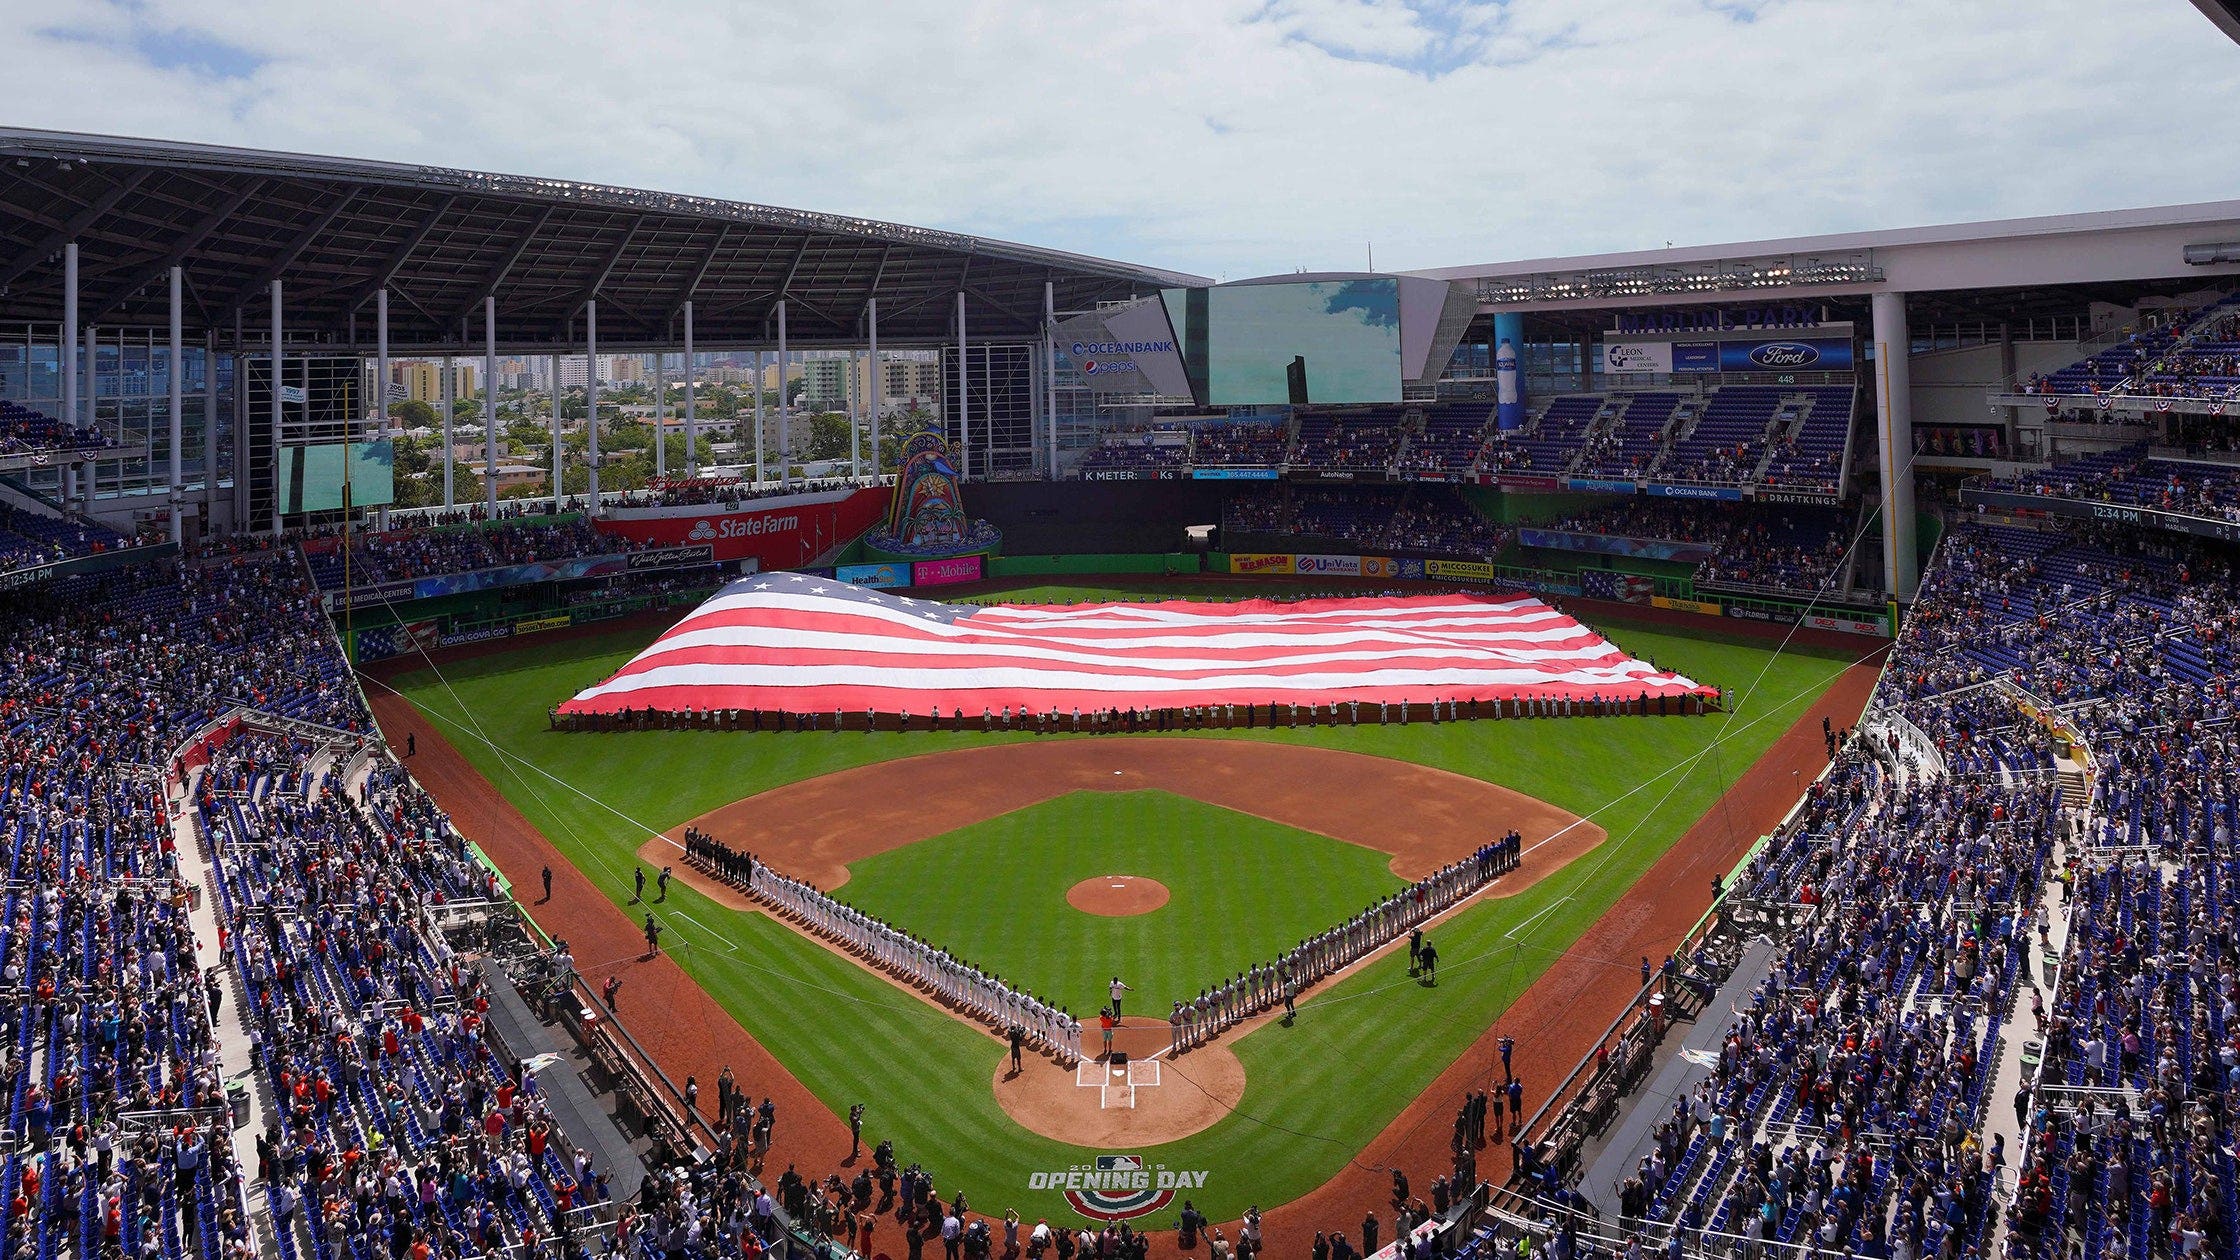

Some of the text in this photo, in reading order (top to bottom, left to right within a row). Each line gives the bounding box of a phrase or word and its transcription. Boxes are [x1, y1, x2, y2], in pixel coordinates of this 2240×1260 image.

[1620, 307, 1820, 334] MARLINS PARK
[1621, 348, 1643, 356] LEON
[1762, 346, 1806, 364] Ford
[1100, 360, 1136, 374] pepsi
[1085, 472, 1093, 480] K
[1097, 471, 1138, 480] METER:
[1160, 471, 1173, 480] Ks
[645, 475, 741, 492] Budweiser
[1675, 488, 1718, 498] OCEAN BANK
[1769, 494, 1837, 505] DRAFTKINGS
[2093, 506, 2139, 522] 12:34 PM
[2164, 523, 2190, 533] MARLINS
[1441, 562, 1491, 572] MICCOSUKEE
[10, 571, 35, 586] 12:34
[38, 568, 53, 580] PM
[384, 587, 412, 598] CENTERS
[1745, 610, 1769, 620] FLORIDA
[1814, 618, 1837, 627] DEX
[1854, 623, 1877, 632] DEX
[1028, 1170, 1210, 1190] OPENING DAY
